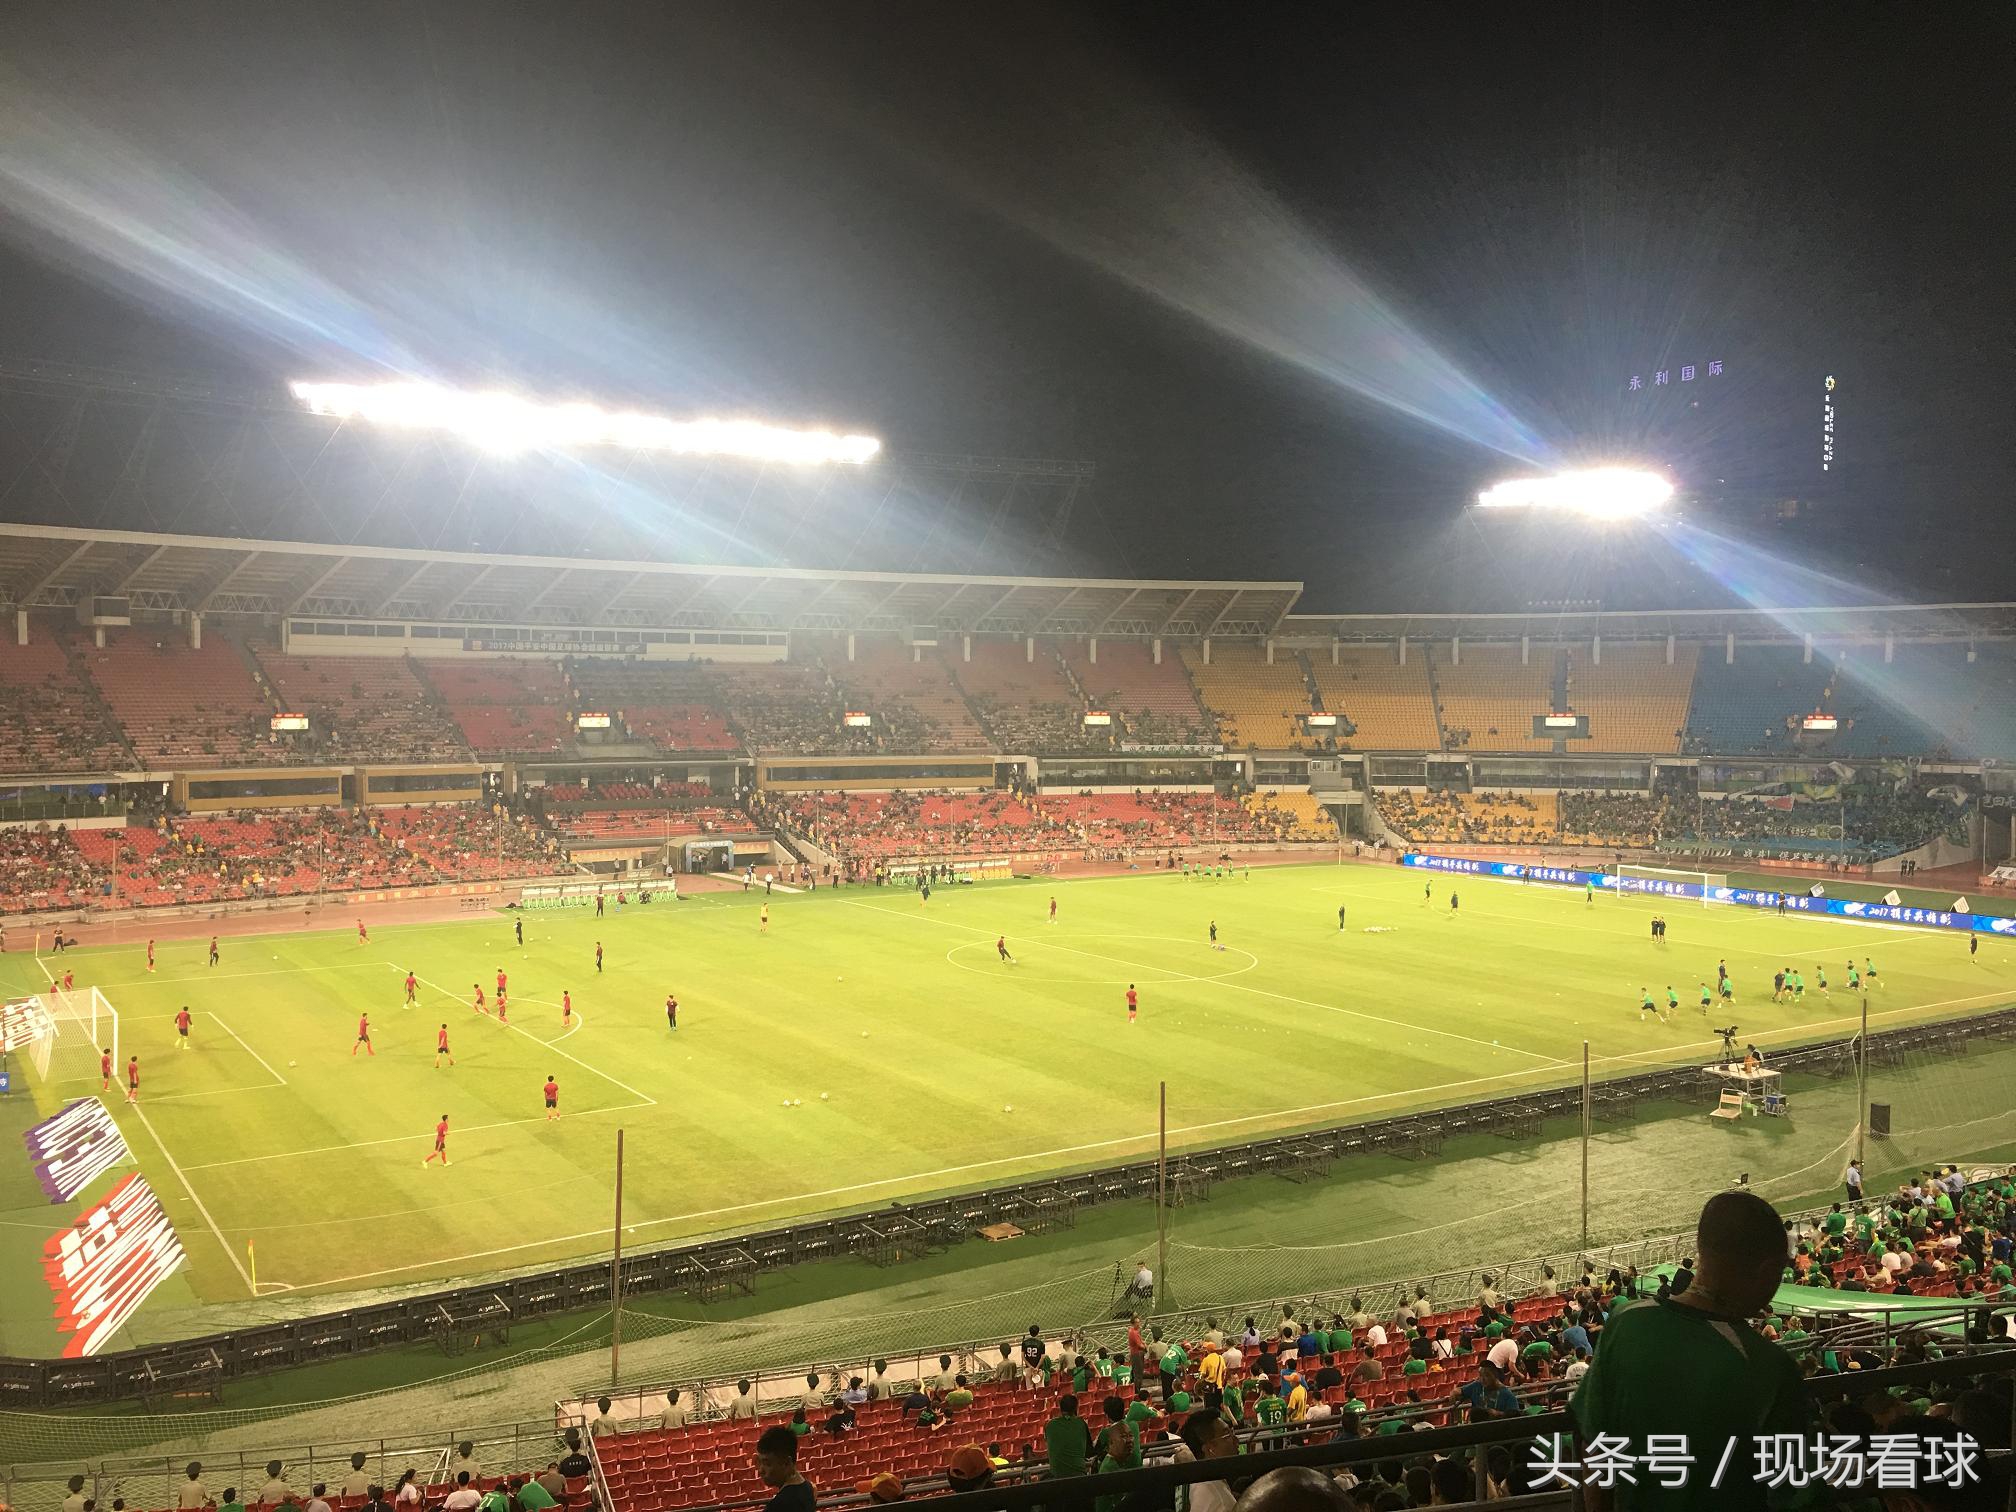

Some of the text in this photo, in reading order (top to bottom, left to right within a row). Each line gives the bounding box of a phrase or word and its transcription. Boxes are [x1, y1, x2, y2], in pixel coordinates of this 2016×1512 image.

[1628, 360, 1723, 391] 永利国际
[1868, 906, 1888, 917] 2017
[1026, 1347, 1038, 1358] 92
[1269, 1410, 1282, 1424] 19
